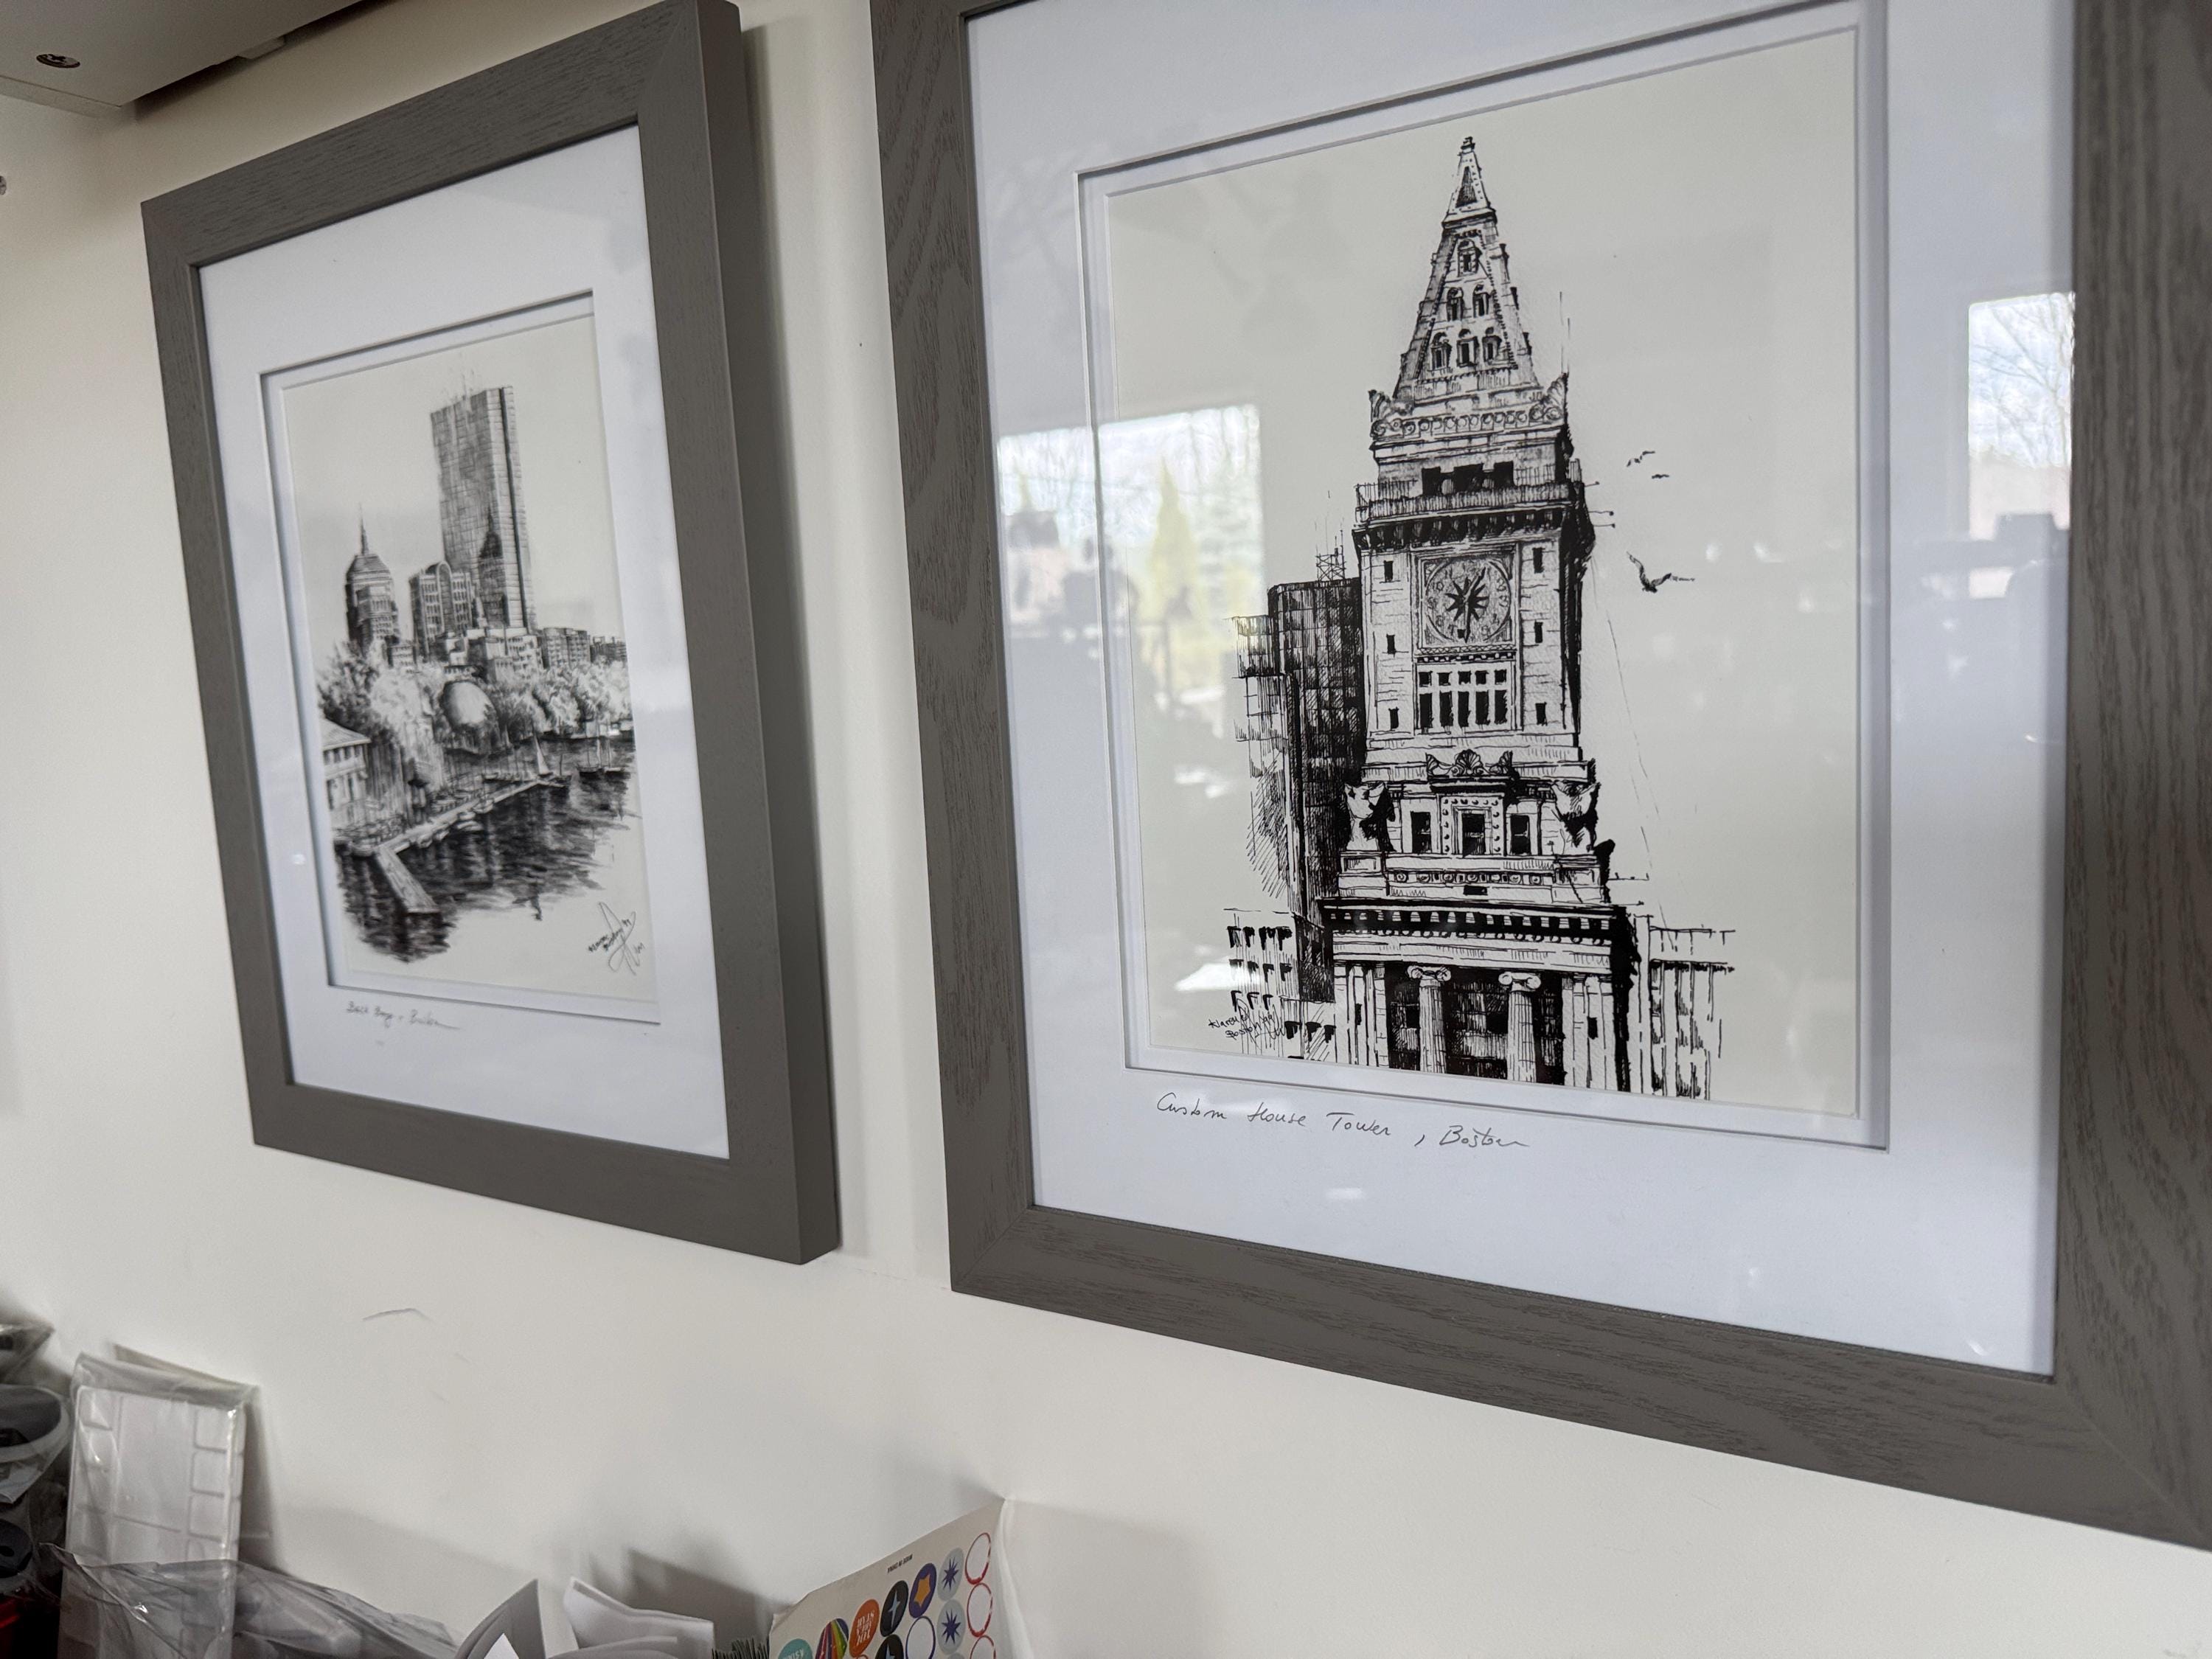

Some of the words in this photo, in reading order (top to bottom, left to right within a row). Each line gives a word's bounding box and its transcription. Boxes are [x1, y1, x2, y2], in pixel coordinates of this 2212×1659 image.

[1157, 1092, 1228, 1119] Custom
[1247, 1102, 1306, 1127] House
[1326, 1112, 1391, 1136] Tower
[1439, 1124, 1530, 1148] Boston
